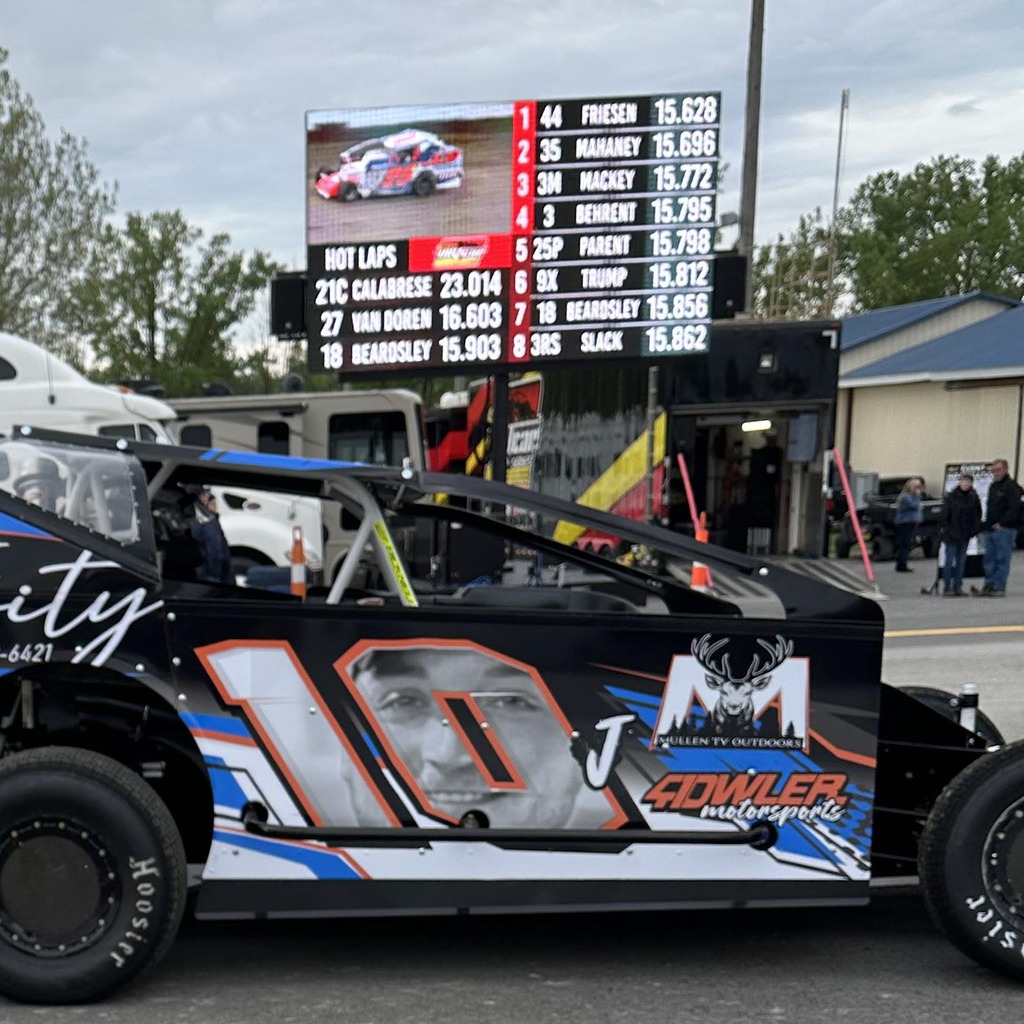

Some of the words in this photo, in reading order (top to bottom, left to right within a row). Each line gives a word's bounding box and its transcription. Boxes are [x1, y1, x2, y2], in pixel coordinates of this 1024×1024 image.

[519, 107, 529, 129] 1
[540, 106, 562, 128] 44
[581, 103, 638, 124] FRIESEN
[654, 97, 717, 124] 15.628
[517, 140, 529, 162] 2
[540, 138, 562, 160] 35
[576, 136, 641, 158] MAHANEY
[652, 131, 716, 157] 15.696
[517, 174, 529, 196] 3
[538, 171, 562, 195] 3M
[579, 169, 636, 191] MACKEY
[652, 164, 712, 190] 15.772
[516, 206, 529, 228] 4
[543, 204, 555, 227] 3
[576, 202, 638, 223] BEHRENT
[651, 197, 712, 223] 15.795
[325, 247, 354, 271] HOT
[357, 245, 397, 270] LAPS
[515, 239, 528, 261] 5
[533, 236, 564, 259] 25P
[579, 235, 631, 257] PARENT
[649, 230, 711, 256] 15.798
[315, 279, 349, 306] 21C
[351, 275, 433, 302] CALABRESE
[439, 271, 502, 298] 23.014
[515, 271, 527, 293] 6
[536, 269, 559, 292] 9X
[581, 267, 628, 289] TRUMP
[649, 261, 709, 287] 15.812
[320, 311, 344, 337] 27
[351, 309, 382, 334] VAN
[439, 304, 501, 330] 16.603
[514, 304, 527, 325] 7
[536, 302, 557, 323] 18
[566, 299, 640, 321] BEARDSLEY
[646, 293, 709, 320] 15.856
[320, 344, 343, 368] 18
[351, 339, 432, 366] BEARDSLEY
[439, 335, 501, 362] 15.903
[512, 335, 526, 358] 8
[531, 332, 561, 356] 3RS
[581, 330, 624, 352] SLACK
[645, 325, 707, 351] 15.862
[659, 735, 708, 748] MULLEN
[711, 736, 729, 747] TV
[731, 737, 803, 749] OUTDOORS
[700, 799, 847, 827] motorsports
